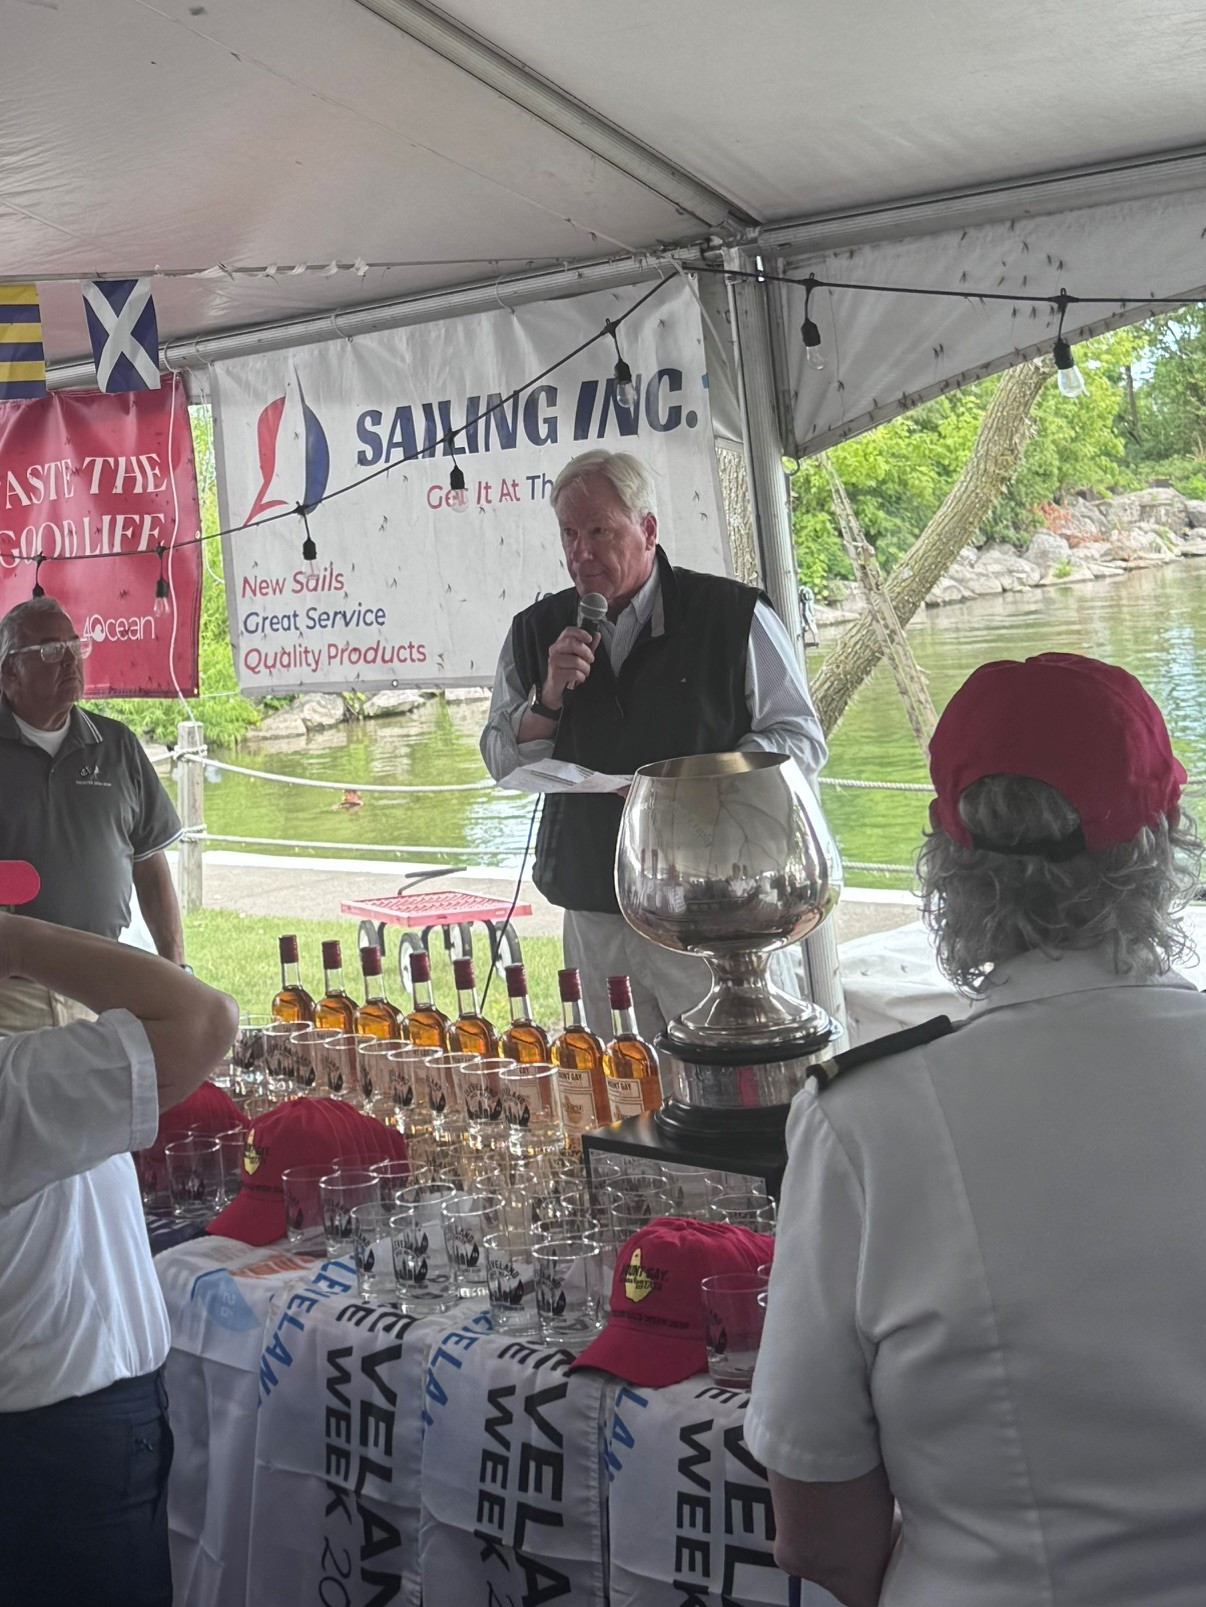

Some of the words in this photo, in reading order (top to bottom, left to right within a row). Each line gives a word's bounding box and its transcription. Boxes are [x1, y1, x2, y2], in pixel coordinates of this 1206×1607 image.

[356, 384, 559, 467] SAILING
[573, 367, 699, 441] INC.
[0, 458, 75, 510] ASTE
[82, 453, 168, 494] THE
[477, 481, 492, 505] It
[499, 478, 521, 503] At
[526, 473, 554, 500] Th
[241, 575, 286, 599] New
[291, 566, 345, 594] Sails
[243, 610, 300, 634] Great
[305, 602, 386, 630] Service
[243, 644, 322, 674] Quality
[327, 640, 427, 666] Products
